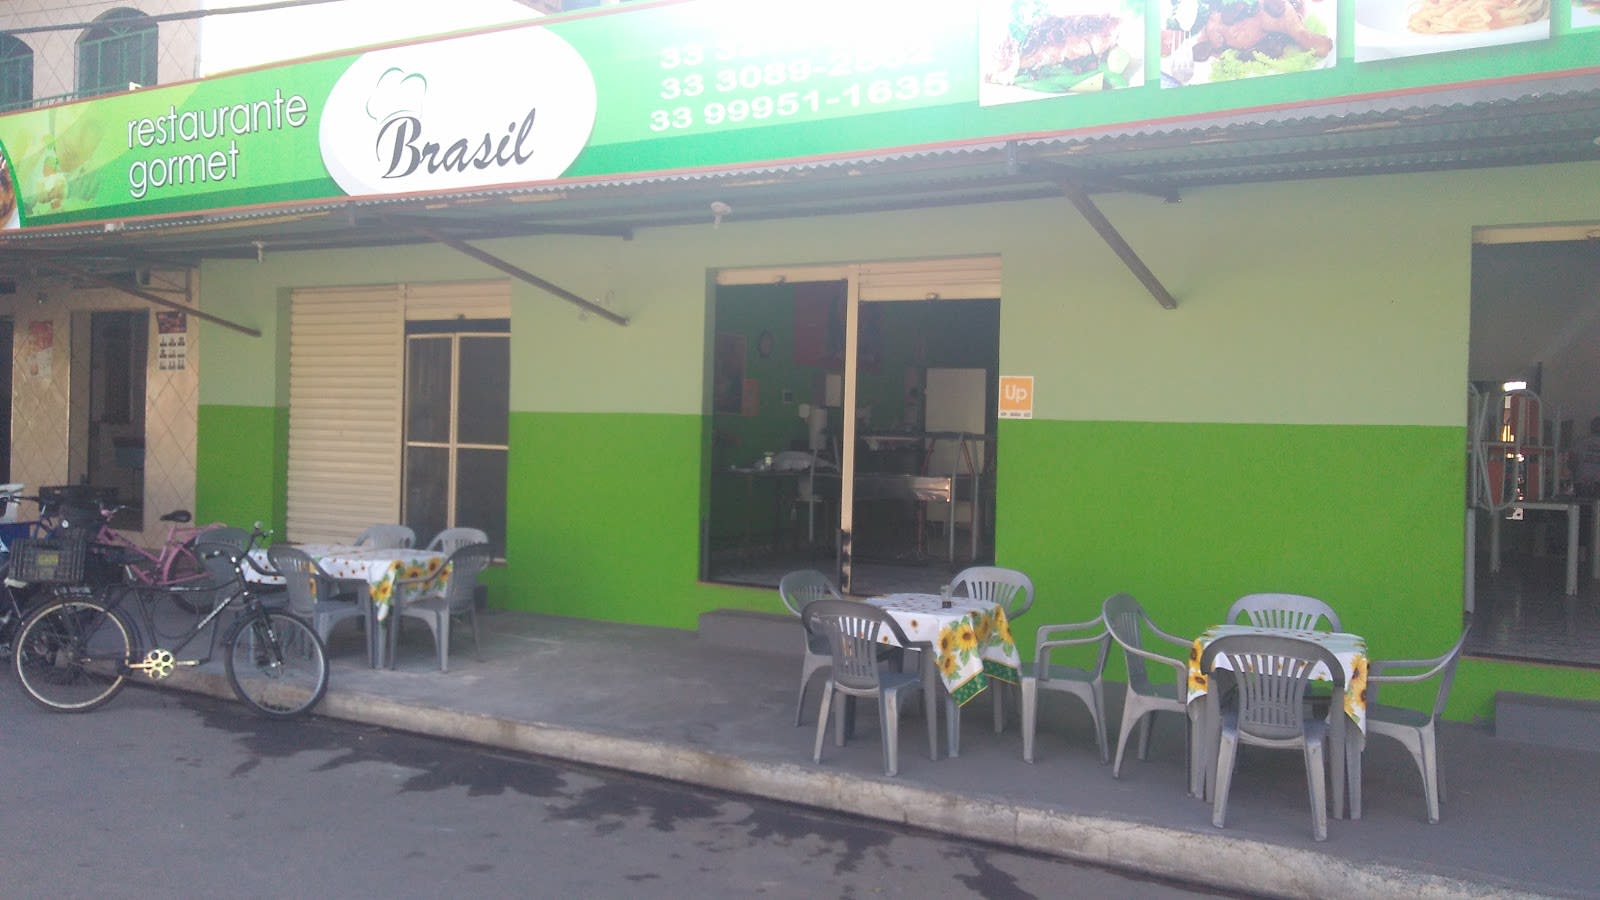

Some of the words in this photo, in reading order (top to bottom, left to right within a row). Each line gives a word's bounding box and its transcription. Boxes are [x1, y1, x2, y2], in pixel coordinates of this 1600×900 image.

[649, 106, 692, 132] 33
[703, 70, 949, 125] 99951-1635
[660, 74, 704, 99] 33
[127, 88, 308, 149] restaurante
[375, 107, 536, 179] Brasil
[129, 140, 239, 198] gormet
[1004, 383, 1028, 405] Up
